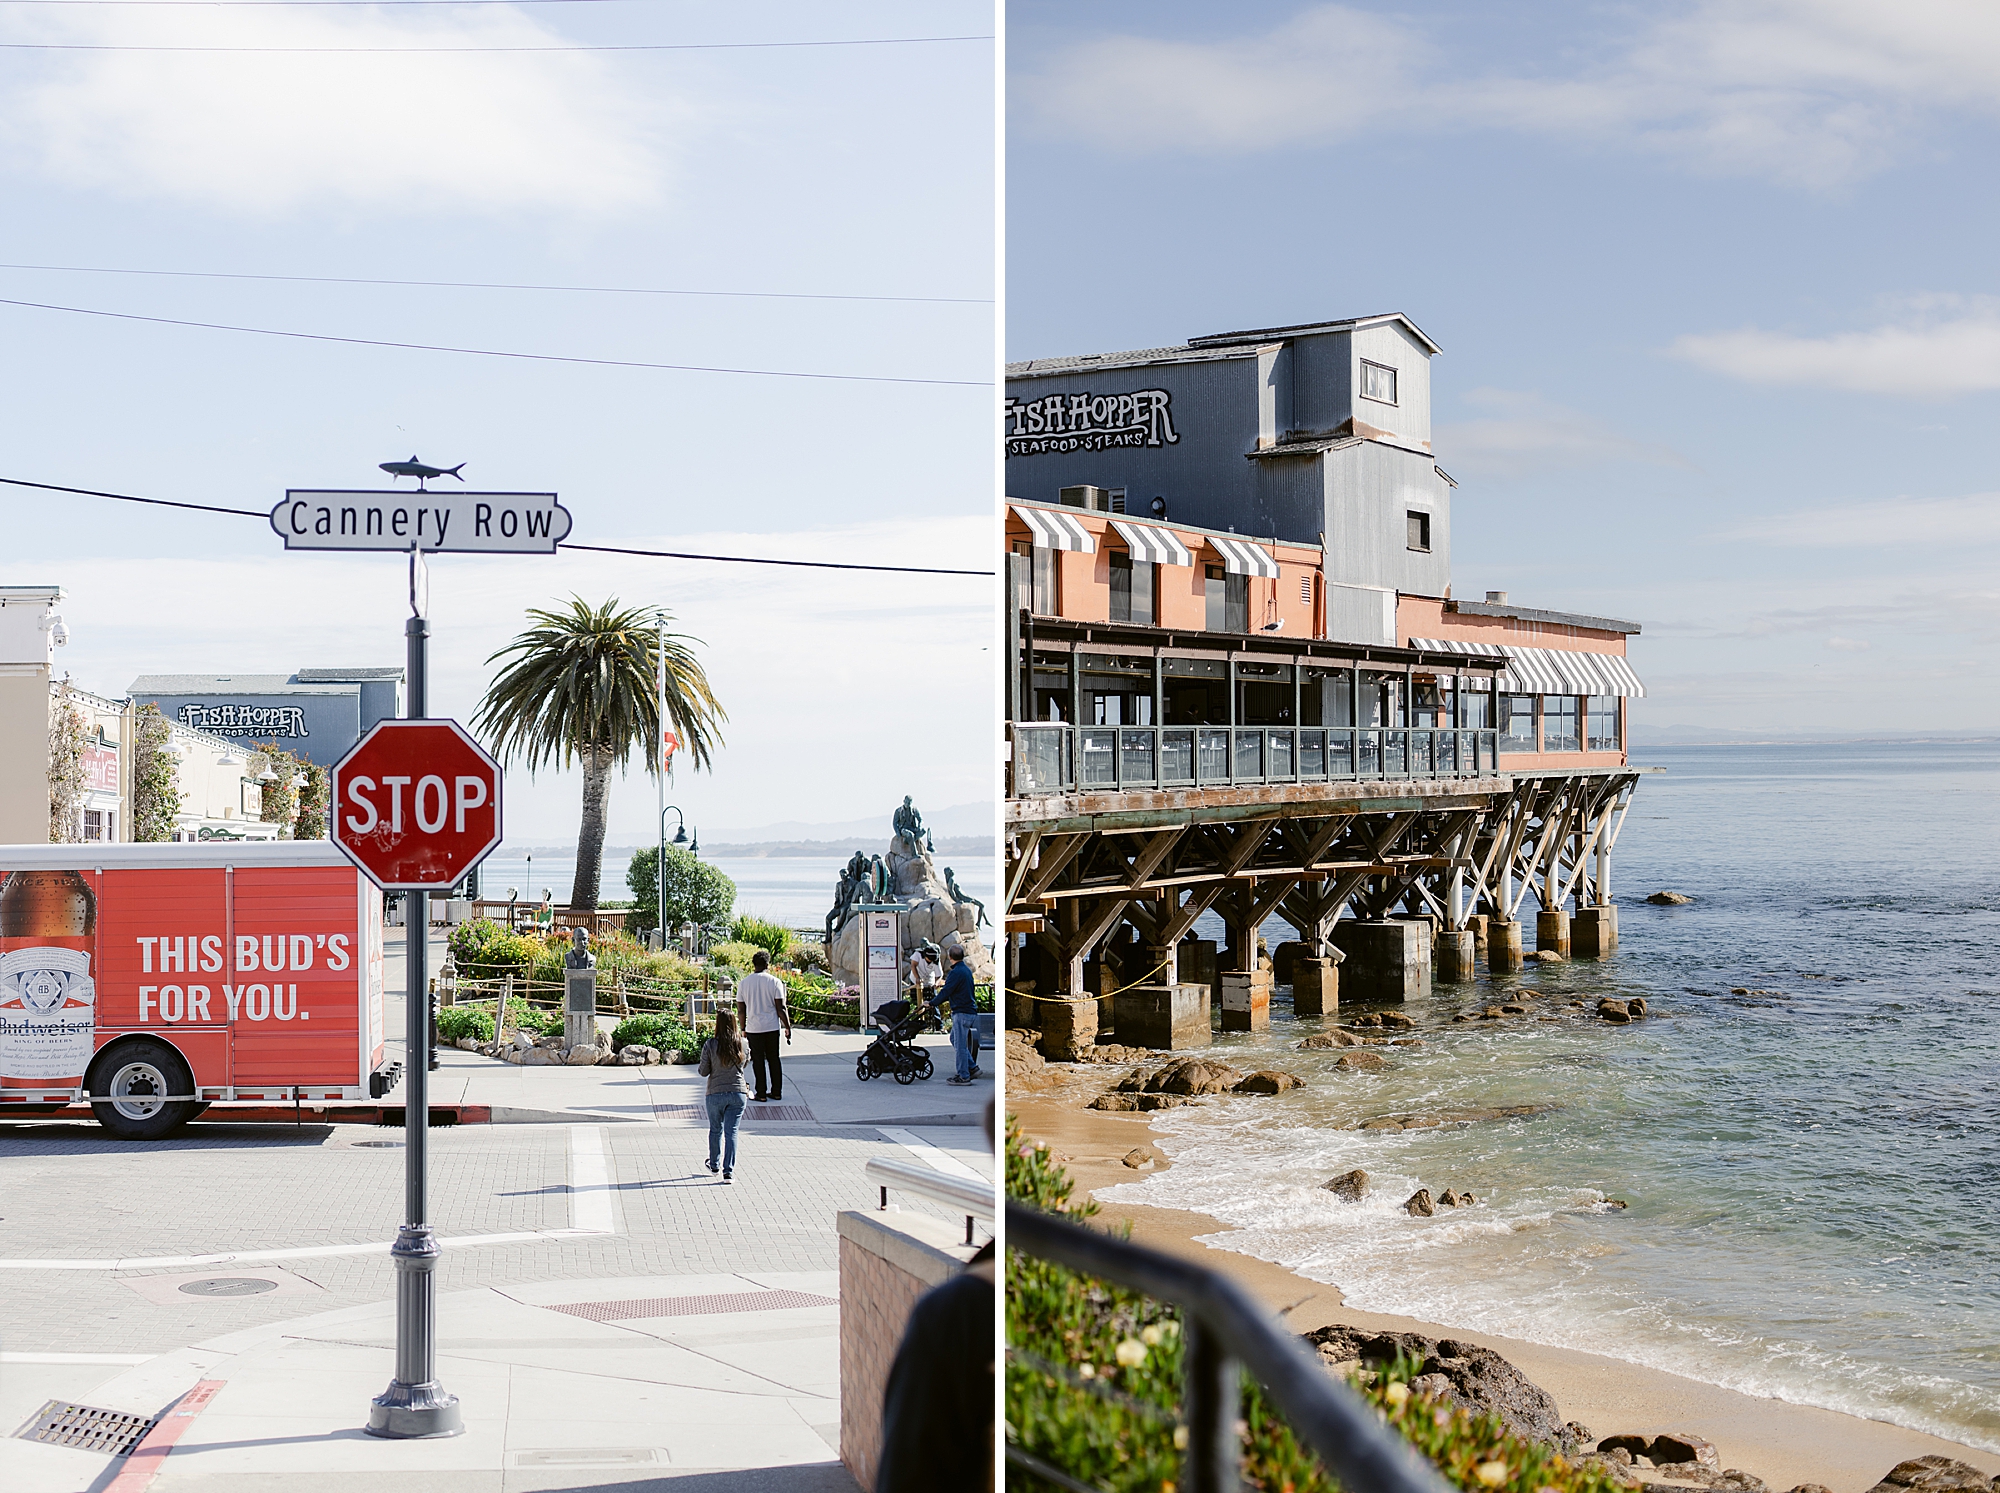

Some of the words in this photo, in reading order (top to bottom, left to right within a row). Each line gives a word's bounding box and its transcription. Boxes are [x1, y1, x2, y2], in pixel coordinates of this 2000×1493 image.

[1069, 390, 1178, 446] HOPPER
[290, 500, 451, 547] Cannery
[475, 502, 553, 538] Row
[185, 704, 236, 731] FISH
[237, 704, 309, 738] HOPPER
[346, 774, 488, 834] STOP
[136, 935, 224, 973] THIS
[235, 933, 350, 971] BUD'S
[139, 984, 211, 1022] FOR
[222, 983, 310, 1021] YOU.
[0, 1017, 91, 1037] Budweiser
